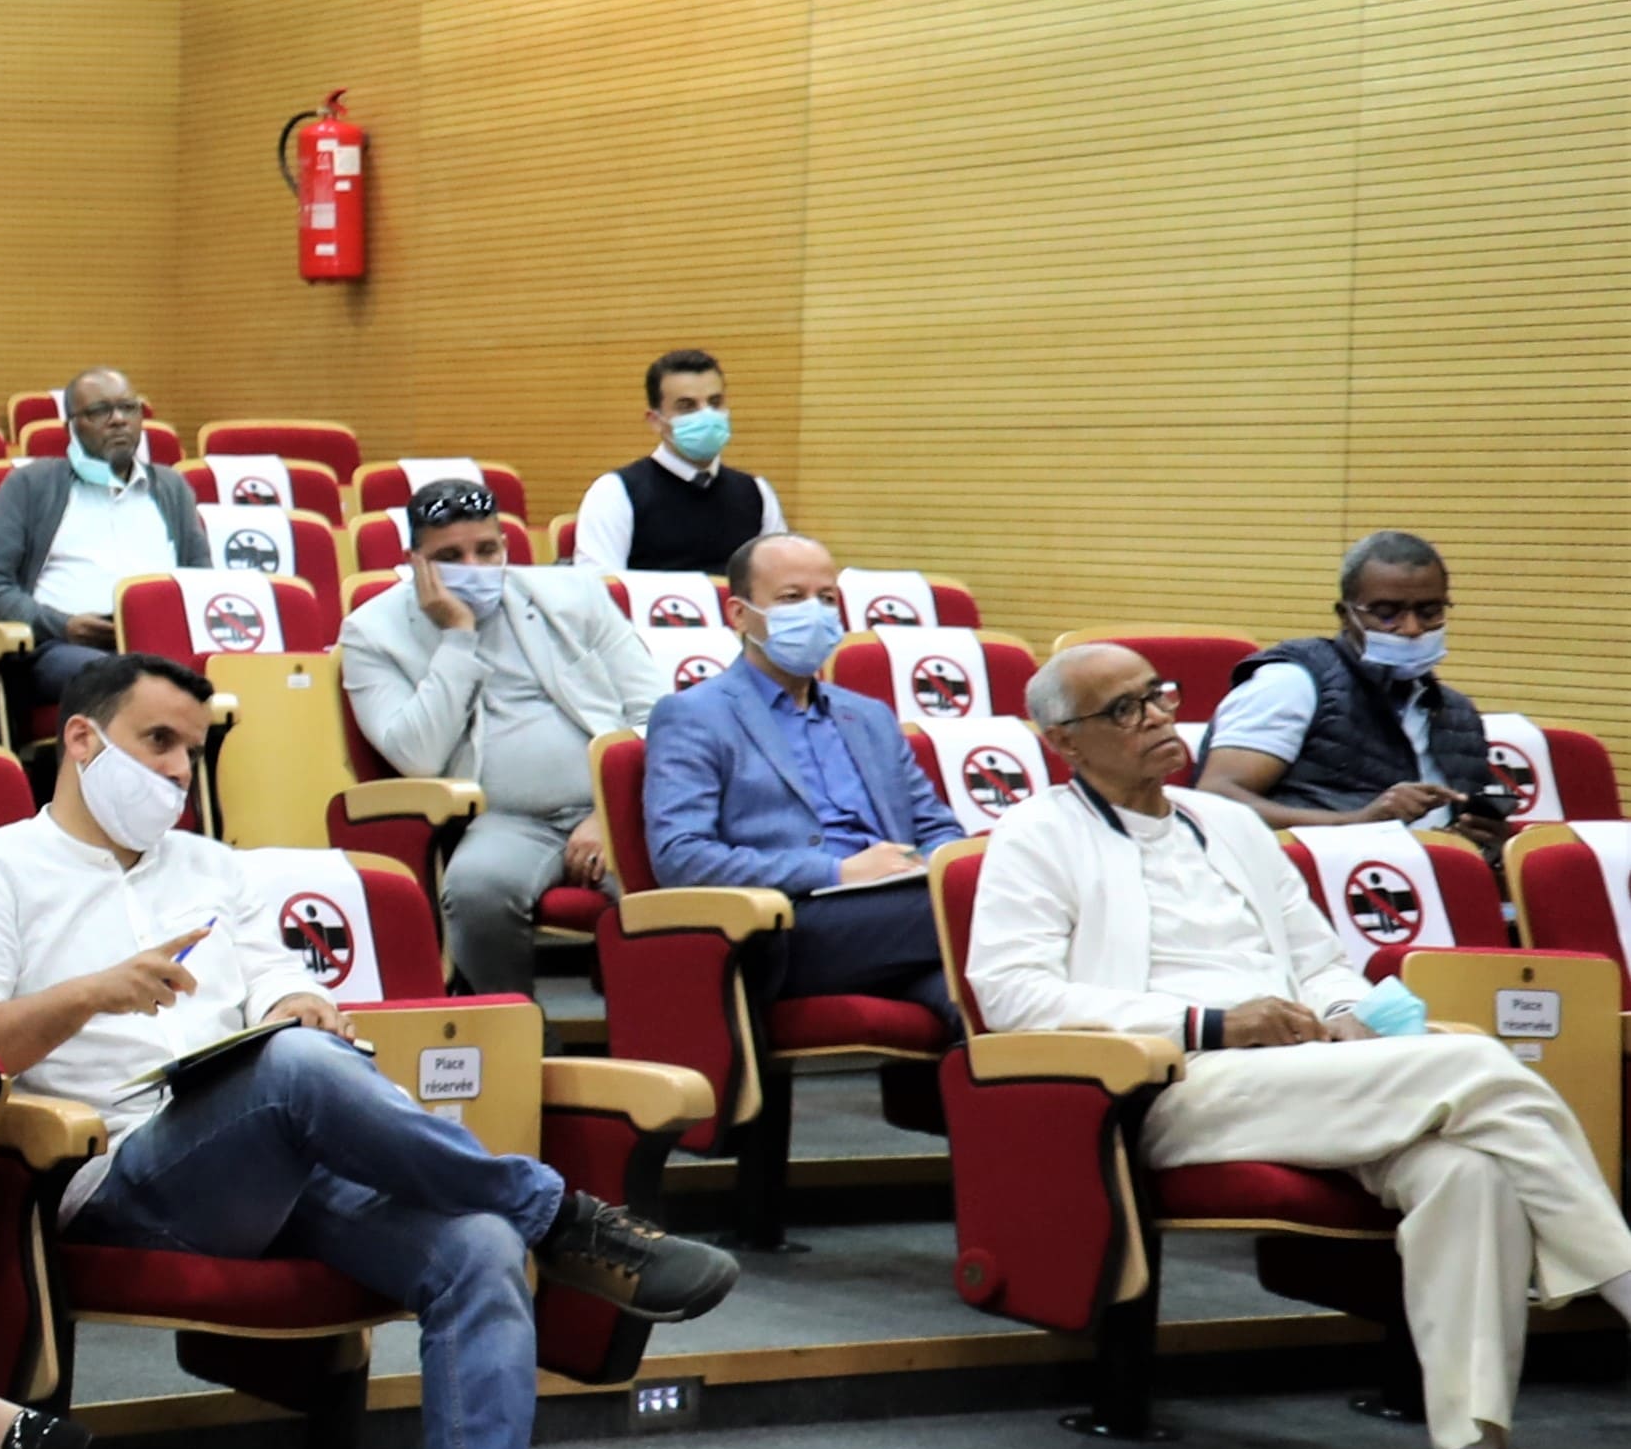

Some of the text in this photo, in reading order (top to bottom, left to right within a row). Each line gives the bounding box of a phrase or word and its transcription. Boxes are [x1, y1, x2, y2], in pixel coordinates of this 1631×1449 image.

[1512, 998, 1544, 1012] Place
[434, 1057, 465, 1071] Place
[424, 1078, 474, 1095] réservée
